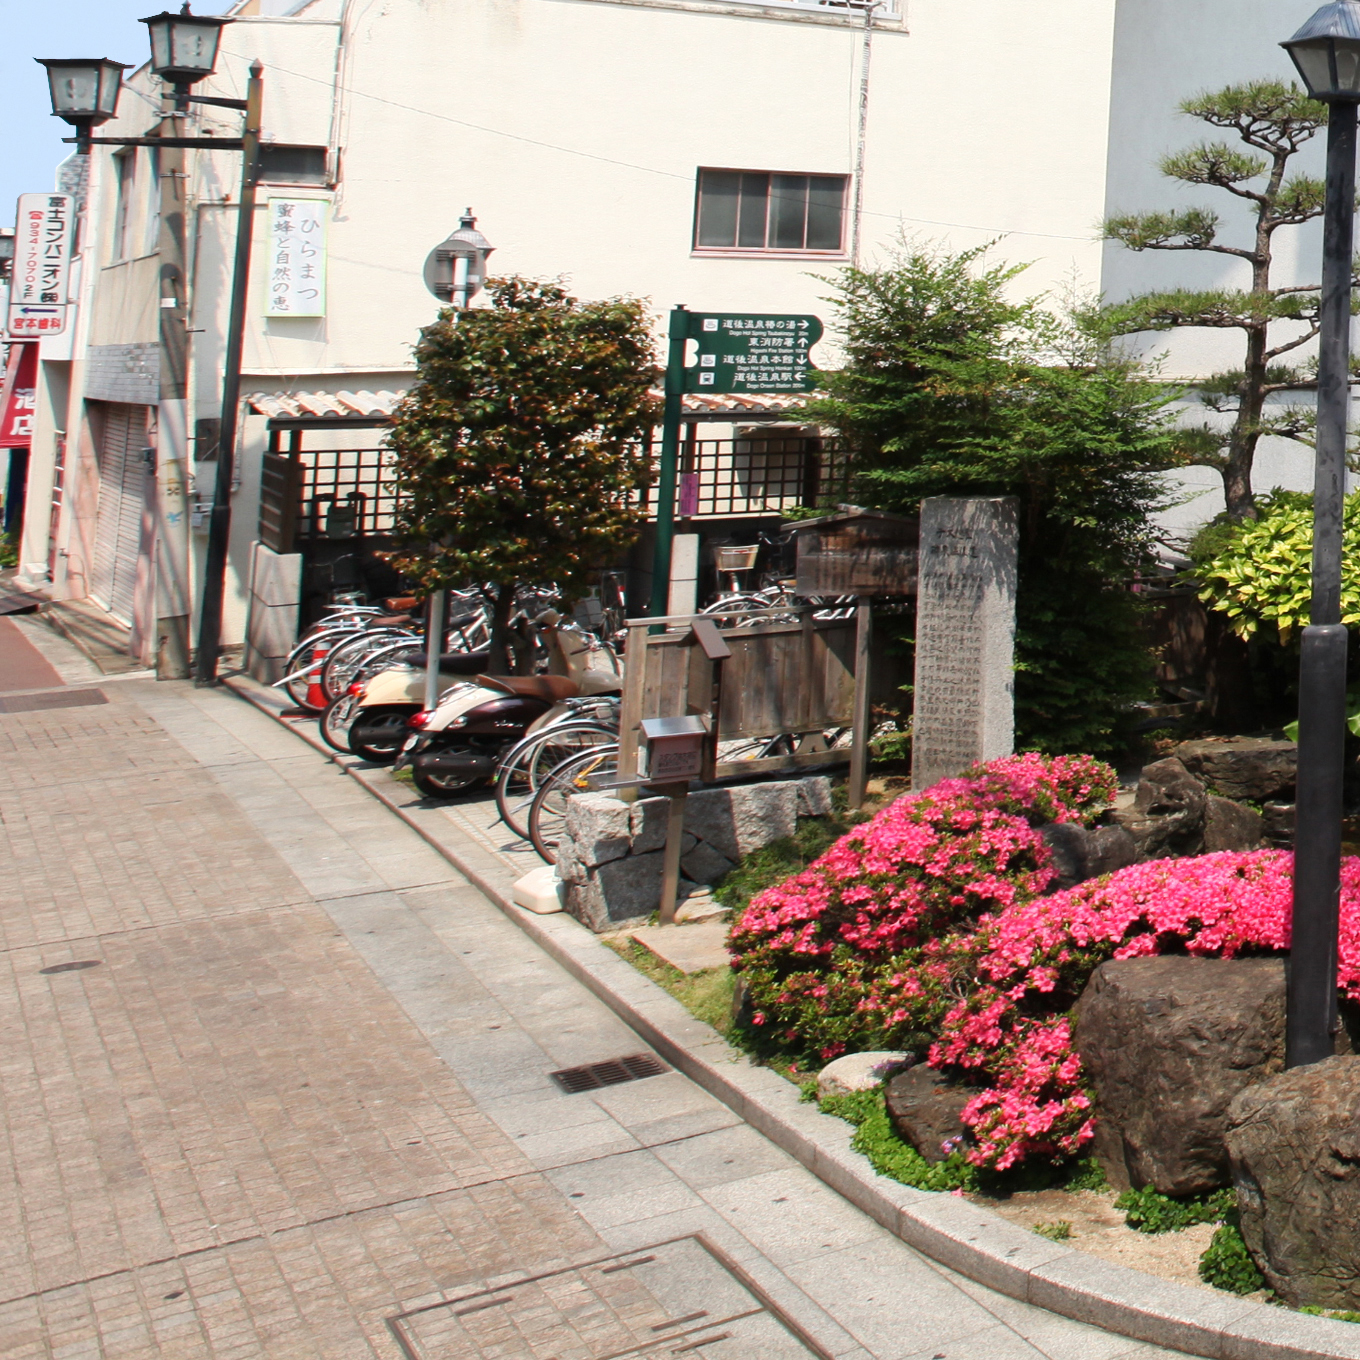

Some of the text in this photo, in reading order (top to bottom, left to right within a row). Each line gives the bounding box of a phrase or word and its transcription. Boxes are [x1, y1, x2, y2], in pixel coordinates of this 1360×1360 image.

[23, 221, 40, 300] 934-7070 2F
[271, 202, 296, 312] 蜜蜂と自然の恵
[297, 218, 320, 300] ひらまつ
[722, 319, 796, 330] 道後温泉椿の湯
[748, 337, 794, 347] 東消防署
[723, 354, 794, 364] 道後温泉本館
[734, 372, 792, 382] 道後温泉駅
